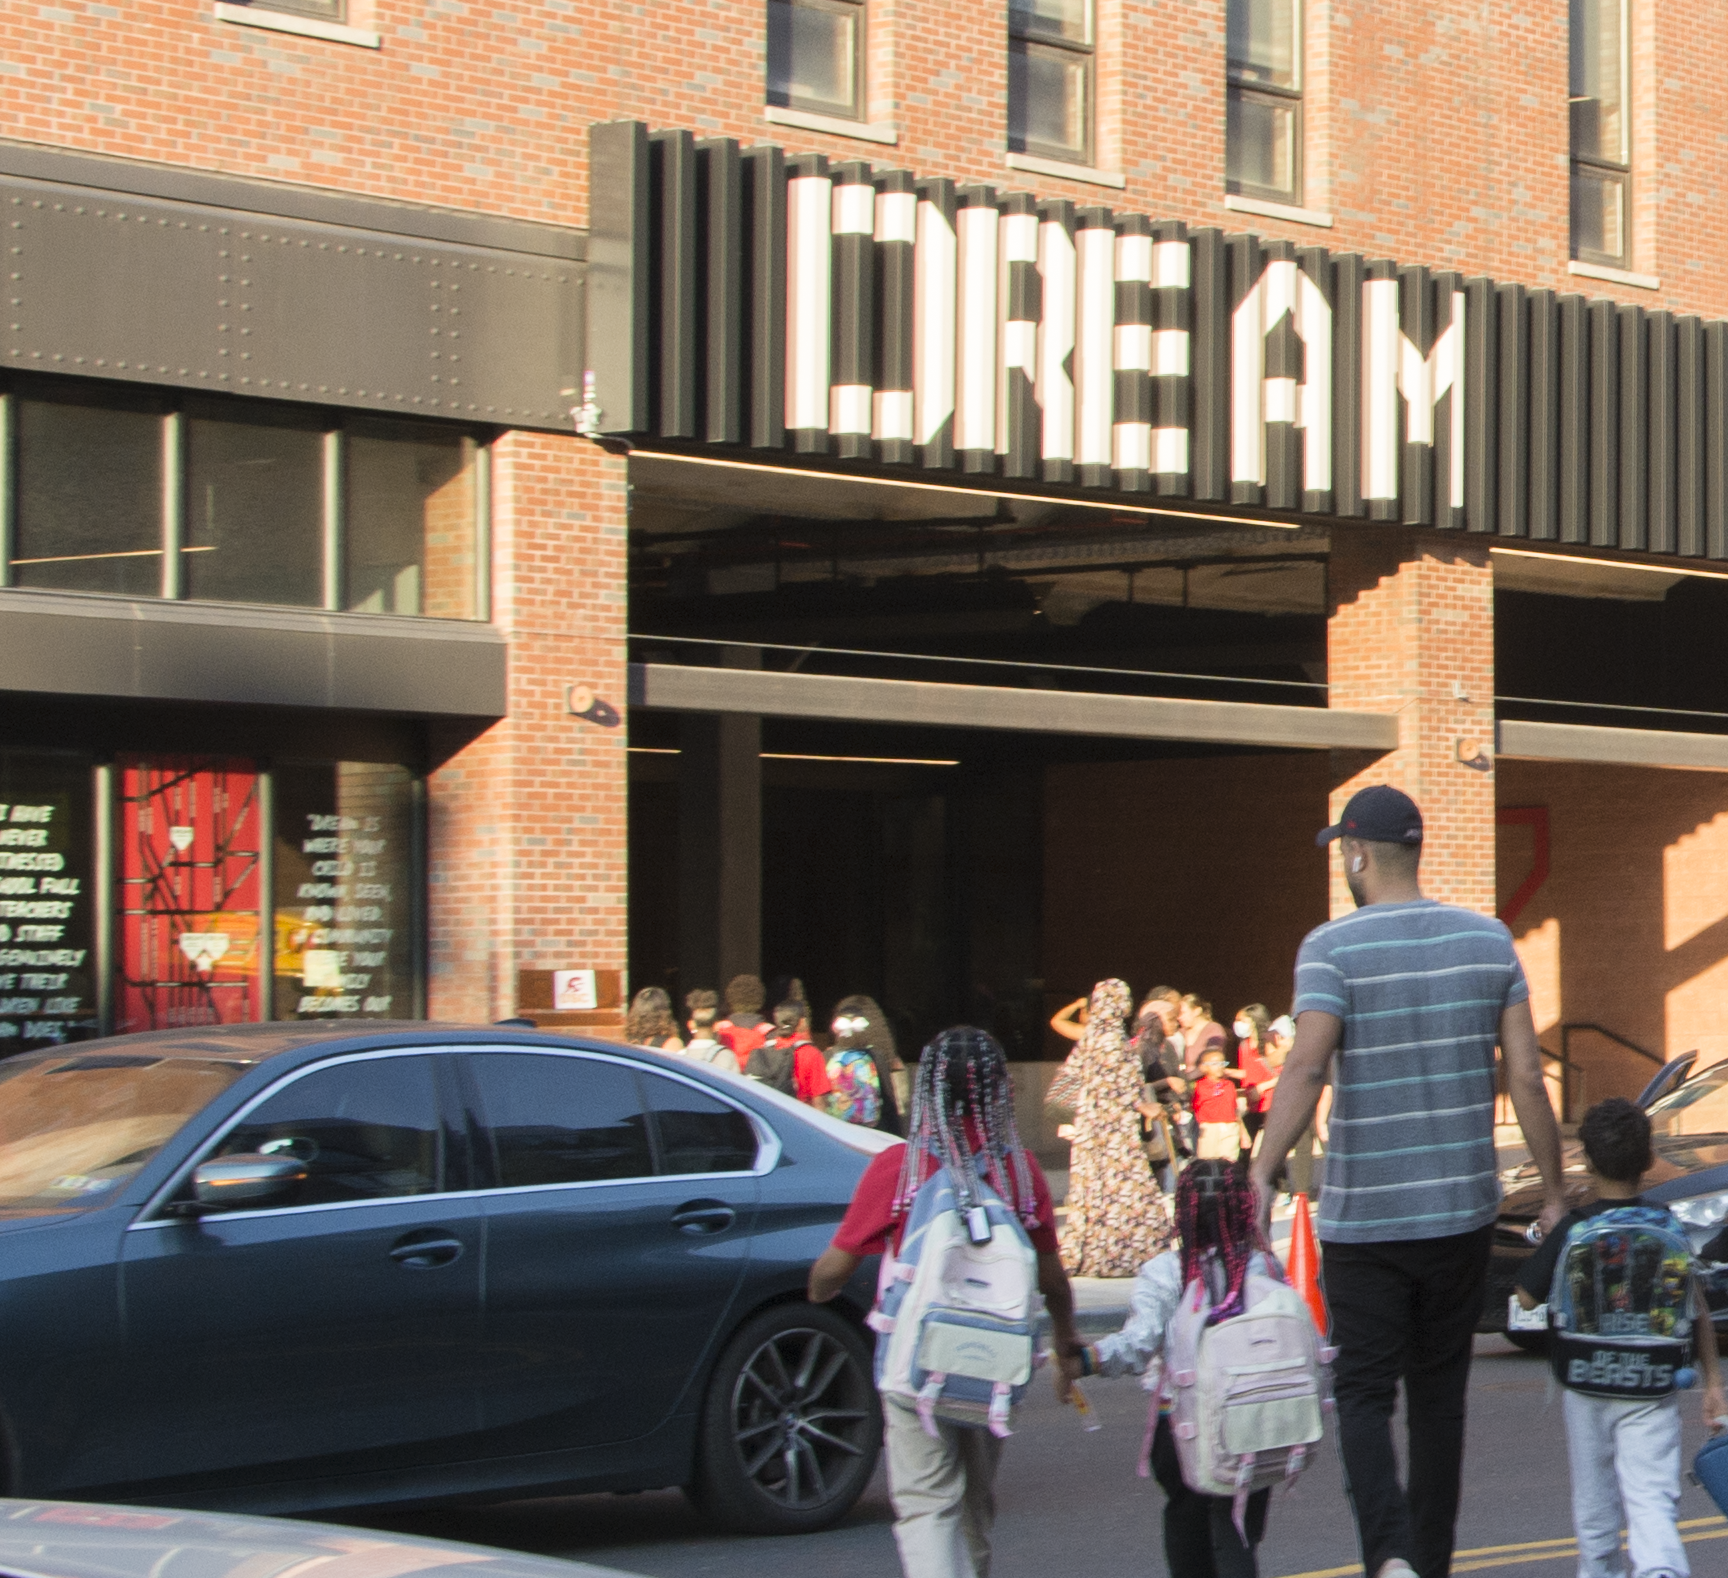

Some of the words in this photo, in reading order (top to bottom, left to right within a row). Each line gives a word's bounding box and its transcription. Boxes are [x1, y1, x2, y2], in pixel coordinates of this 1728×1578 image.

[785, 177, 1465, 508] DREAM
[1568, 1358, 1675, 1388] BEASTS
[1592, 1350, 1617, 1367] OF
[1618, 1352, 1650, 1367] THE
